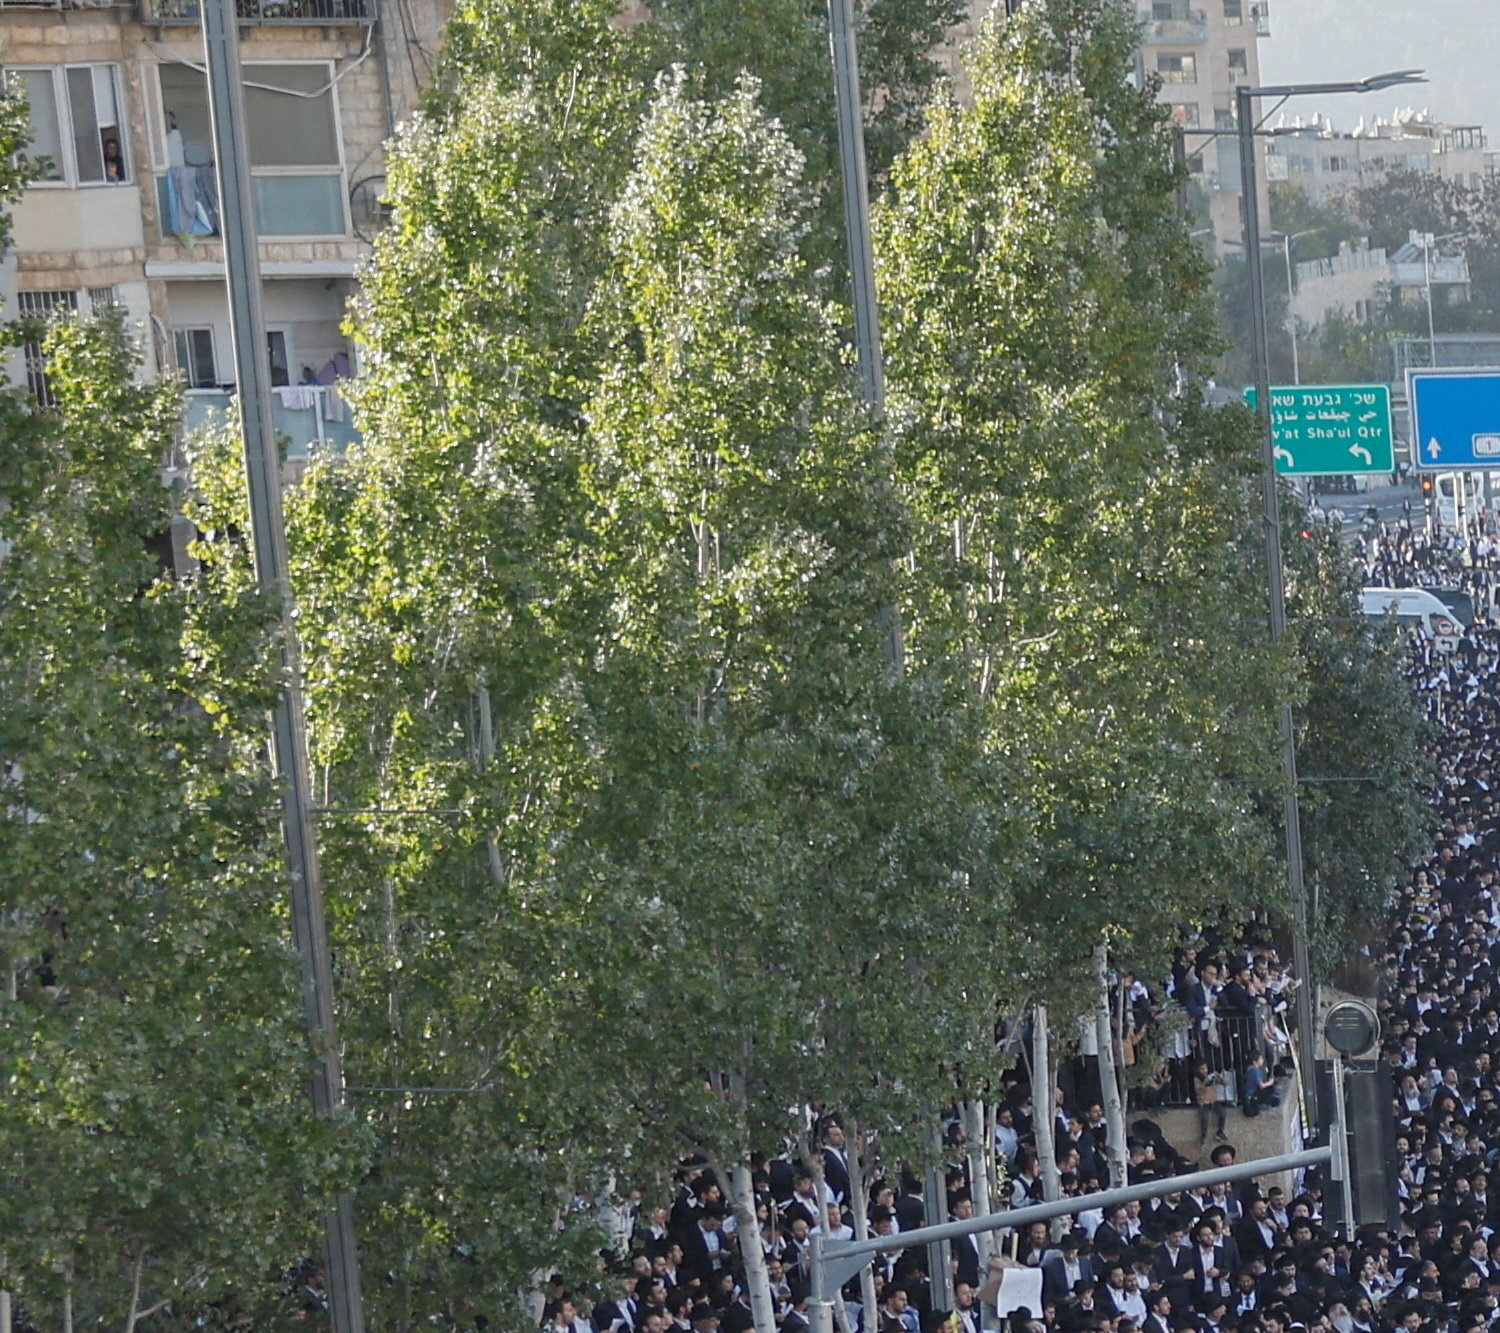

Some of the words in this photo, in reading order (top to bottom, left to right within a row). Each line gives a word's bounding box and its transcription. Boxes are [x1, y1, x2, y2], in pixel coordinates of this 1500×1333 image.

[1272, 394, 1295, 407] שא
[1302, 393, 1342, 406] גבעת
[1272, 428, 1300, 439] v'at
[1307, 427, 1351, 439] Sha'ul
[1358, 425, 1383, 440] Qtr
